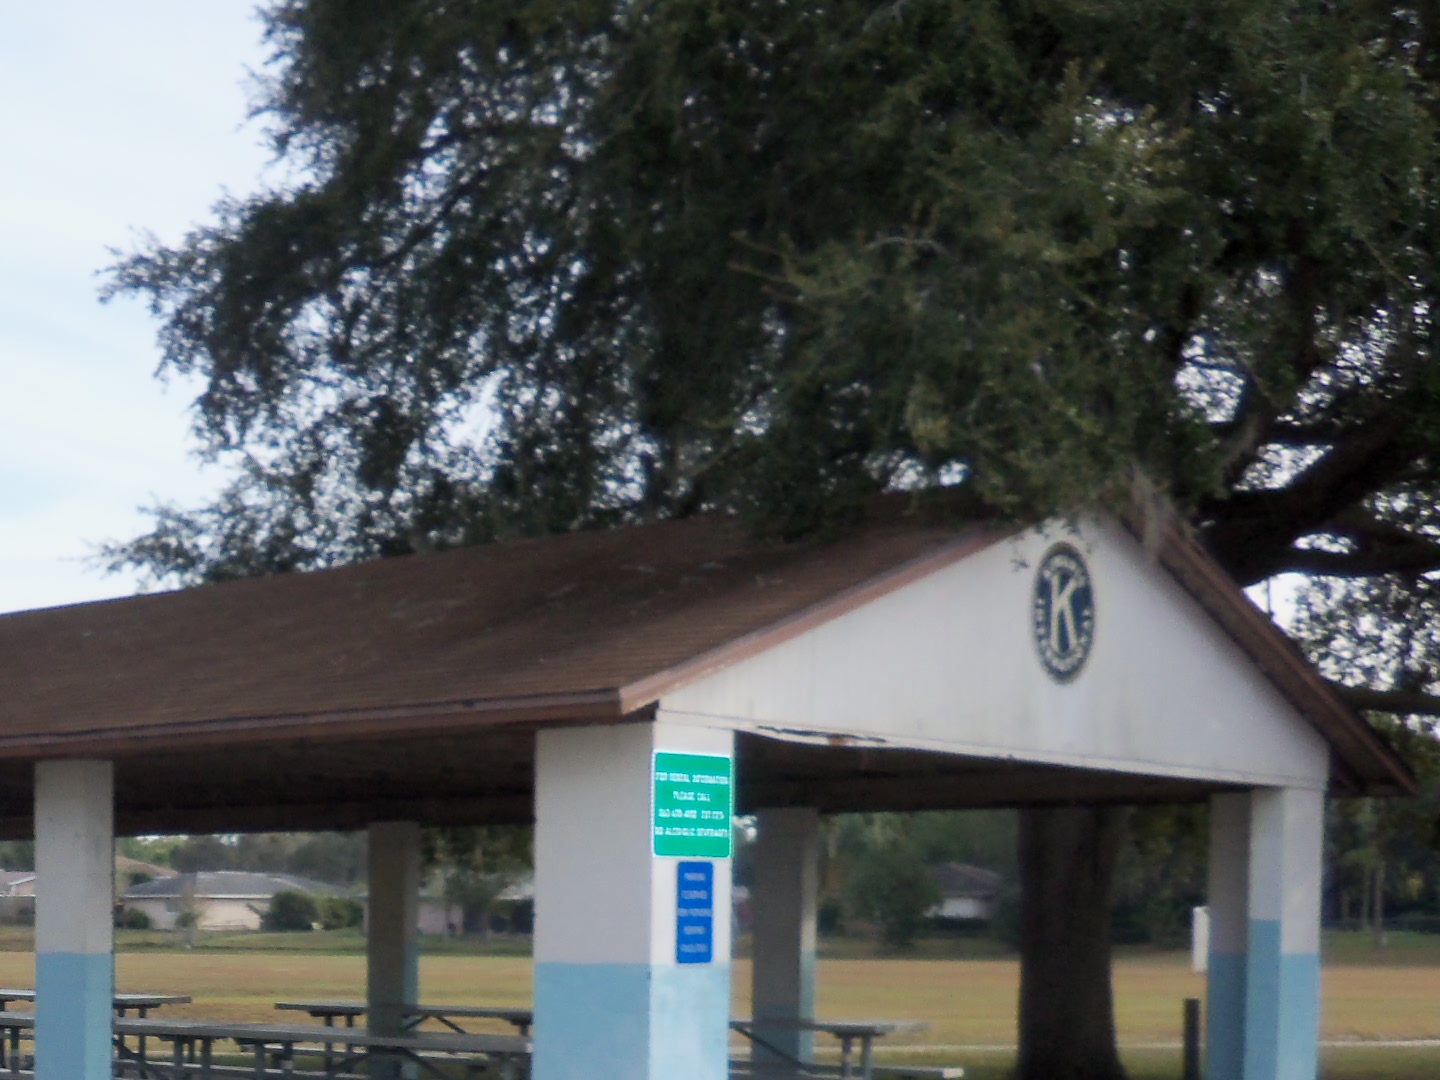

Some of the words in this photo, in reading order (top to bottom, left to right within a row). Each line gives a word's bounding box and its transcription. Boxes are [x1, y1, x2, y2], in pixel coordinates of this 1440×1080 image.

[1050, 573, 1078, 653] K
[673, 790, 695, 801] PLEASE
[697, 792, 711, 802] CALL
